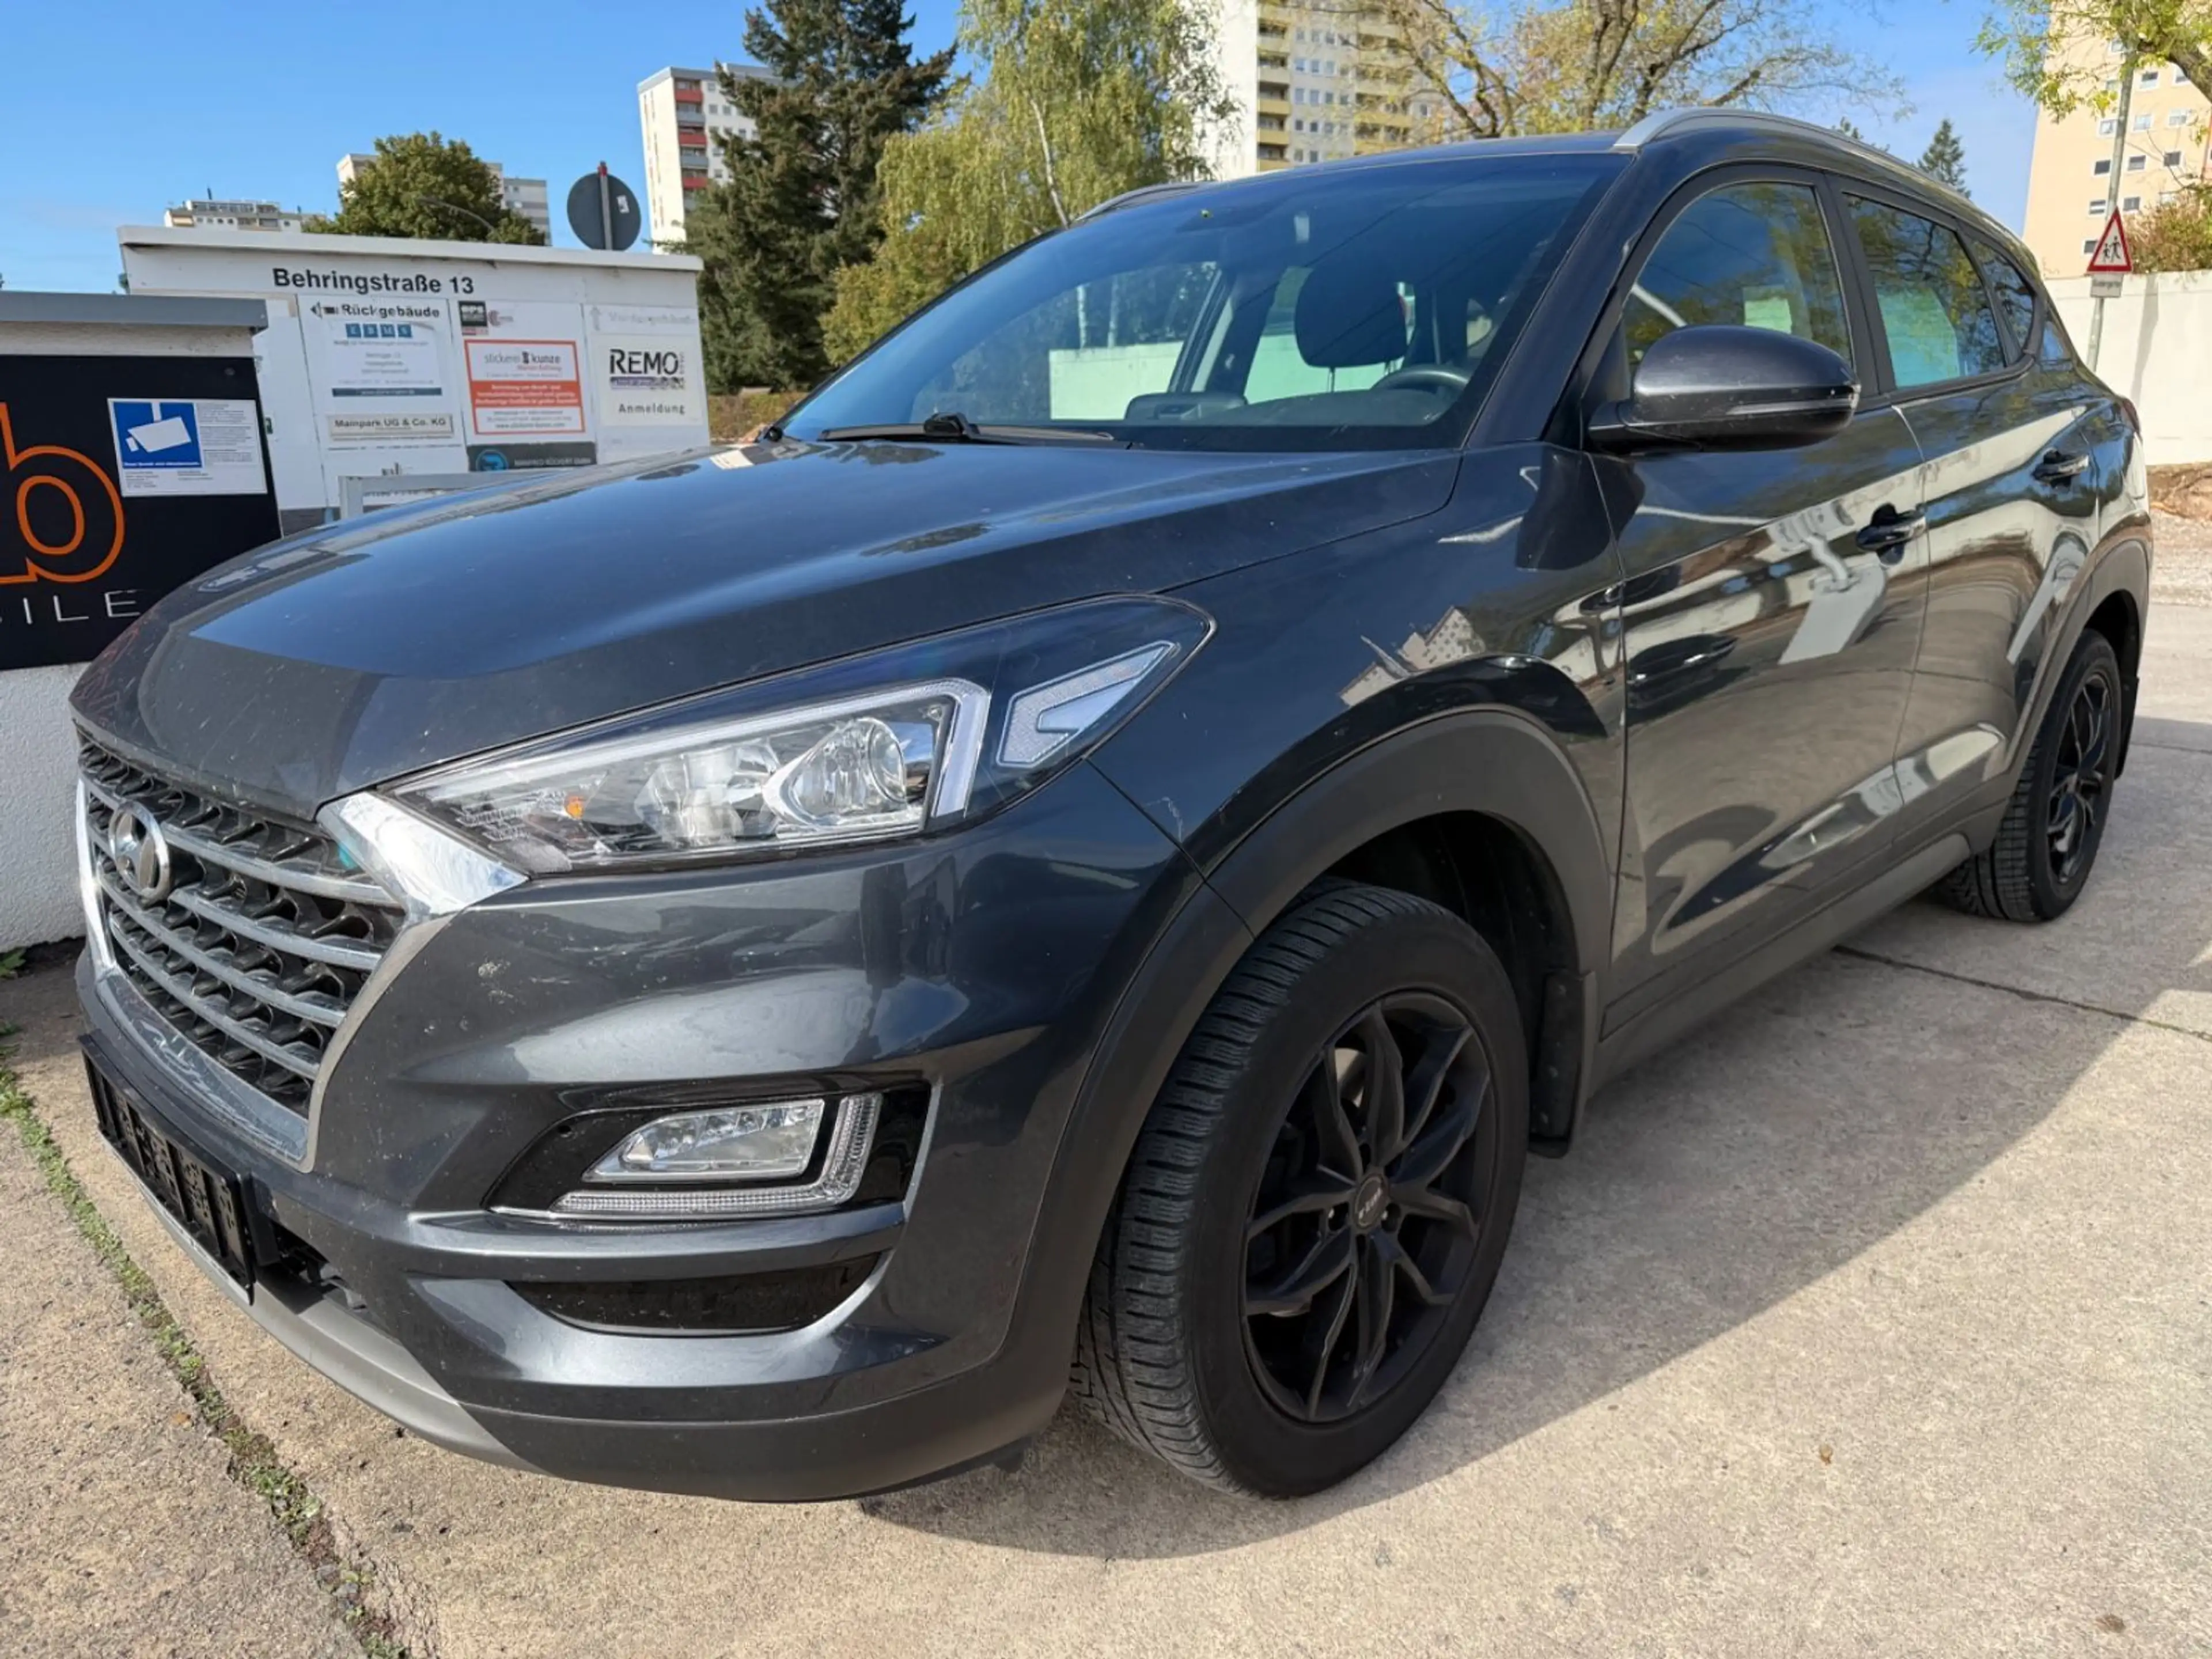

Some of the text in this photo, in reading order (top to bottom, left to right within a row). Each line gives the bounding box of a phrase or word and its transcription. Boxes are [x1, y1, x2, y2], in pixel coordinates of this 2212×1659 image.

[272, 267, 474, 295] Behringstraße 13
[341, 304, 440, 318] Rückgebäude
[531, 354, 561, 364] kunze
[609, 349, 679, 375] REMO
[619, 403, 686, 415] Anmeldung
[384, 418, 399, 427] UG
[402, 418, 410, 426] &
[412, 418, 427, 426] Co.
[431, 418, 446, 426] KG
[0, 589, 141, 624] ILE
